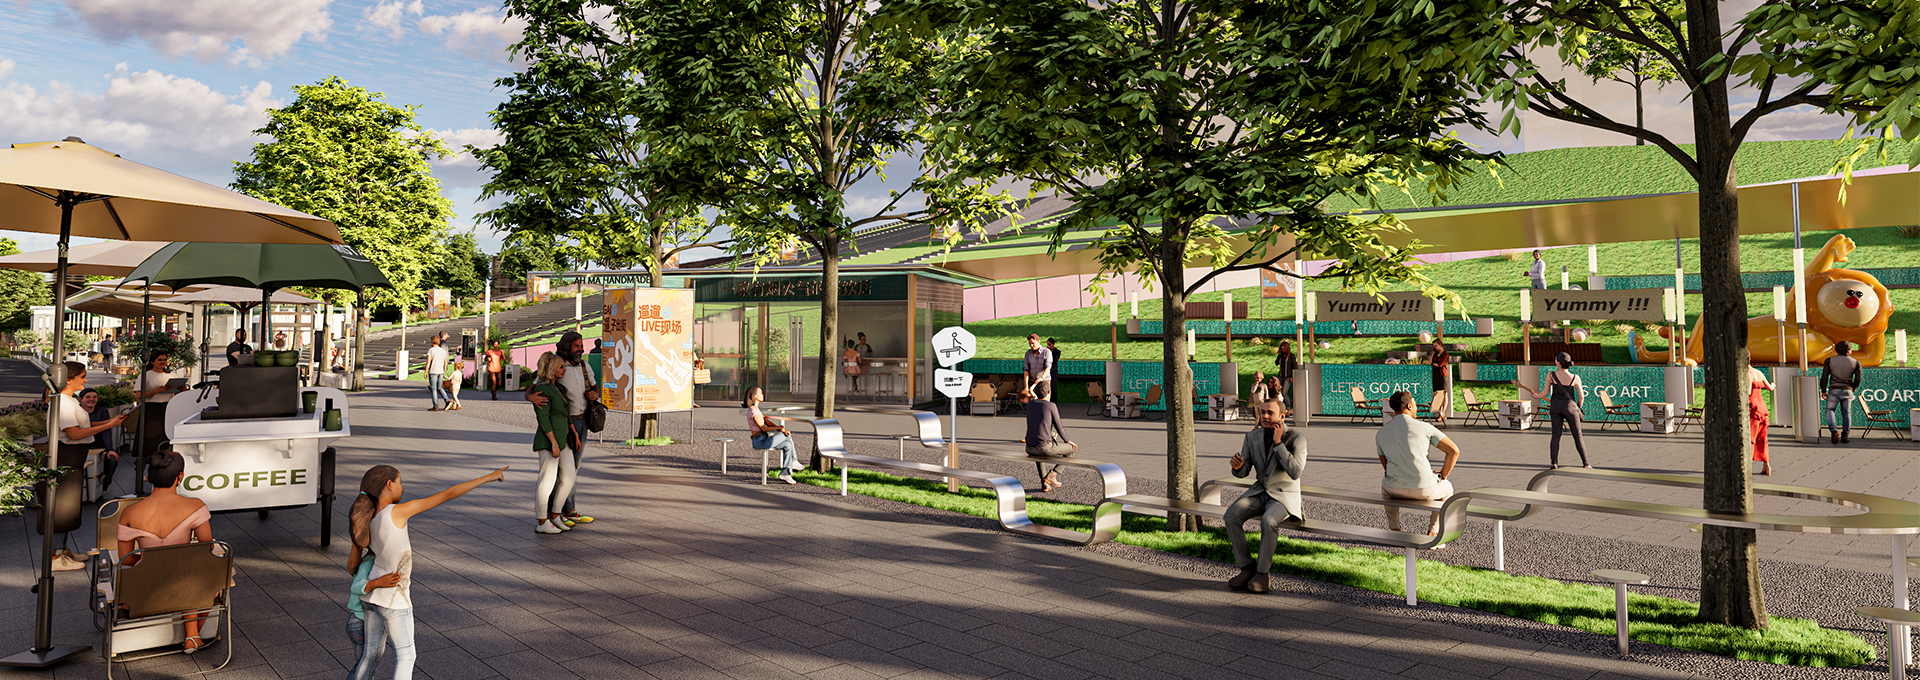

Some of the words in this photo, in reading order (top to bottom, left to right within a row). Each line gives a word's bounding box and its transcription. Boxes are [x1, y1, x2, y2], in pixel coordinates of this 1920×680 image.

[588, 276, 601, 284] MA
[603, 275, 650, 284] HANDMADE
[722, 279, 872, 297] 一家有烟火气的饮店
[1327, 299, 1396, 315] Yummy
[1401, 299, 1422, 312] !!!
[1544, 298, 1621, 314] Yummy
[1627, 298, 1650, 311] !!!
[641, 320, 682, 336] LIVE现场
[1331, 382, 1365, 393] LET'S
[1369, 382, 1390, 393] GO
[1392, 382, 1420, 394] ART
[1620, 386, 1651, 398] ART
[1861, 388, 1888, 402] GO
[183, 468, 307, 492] COFFEE
